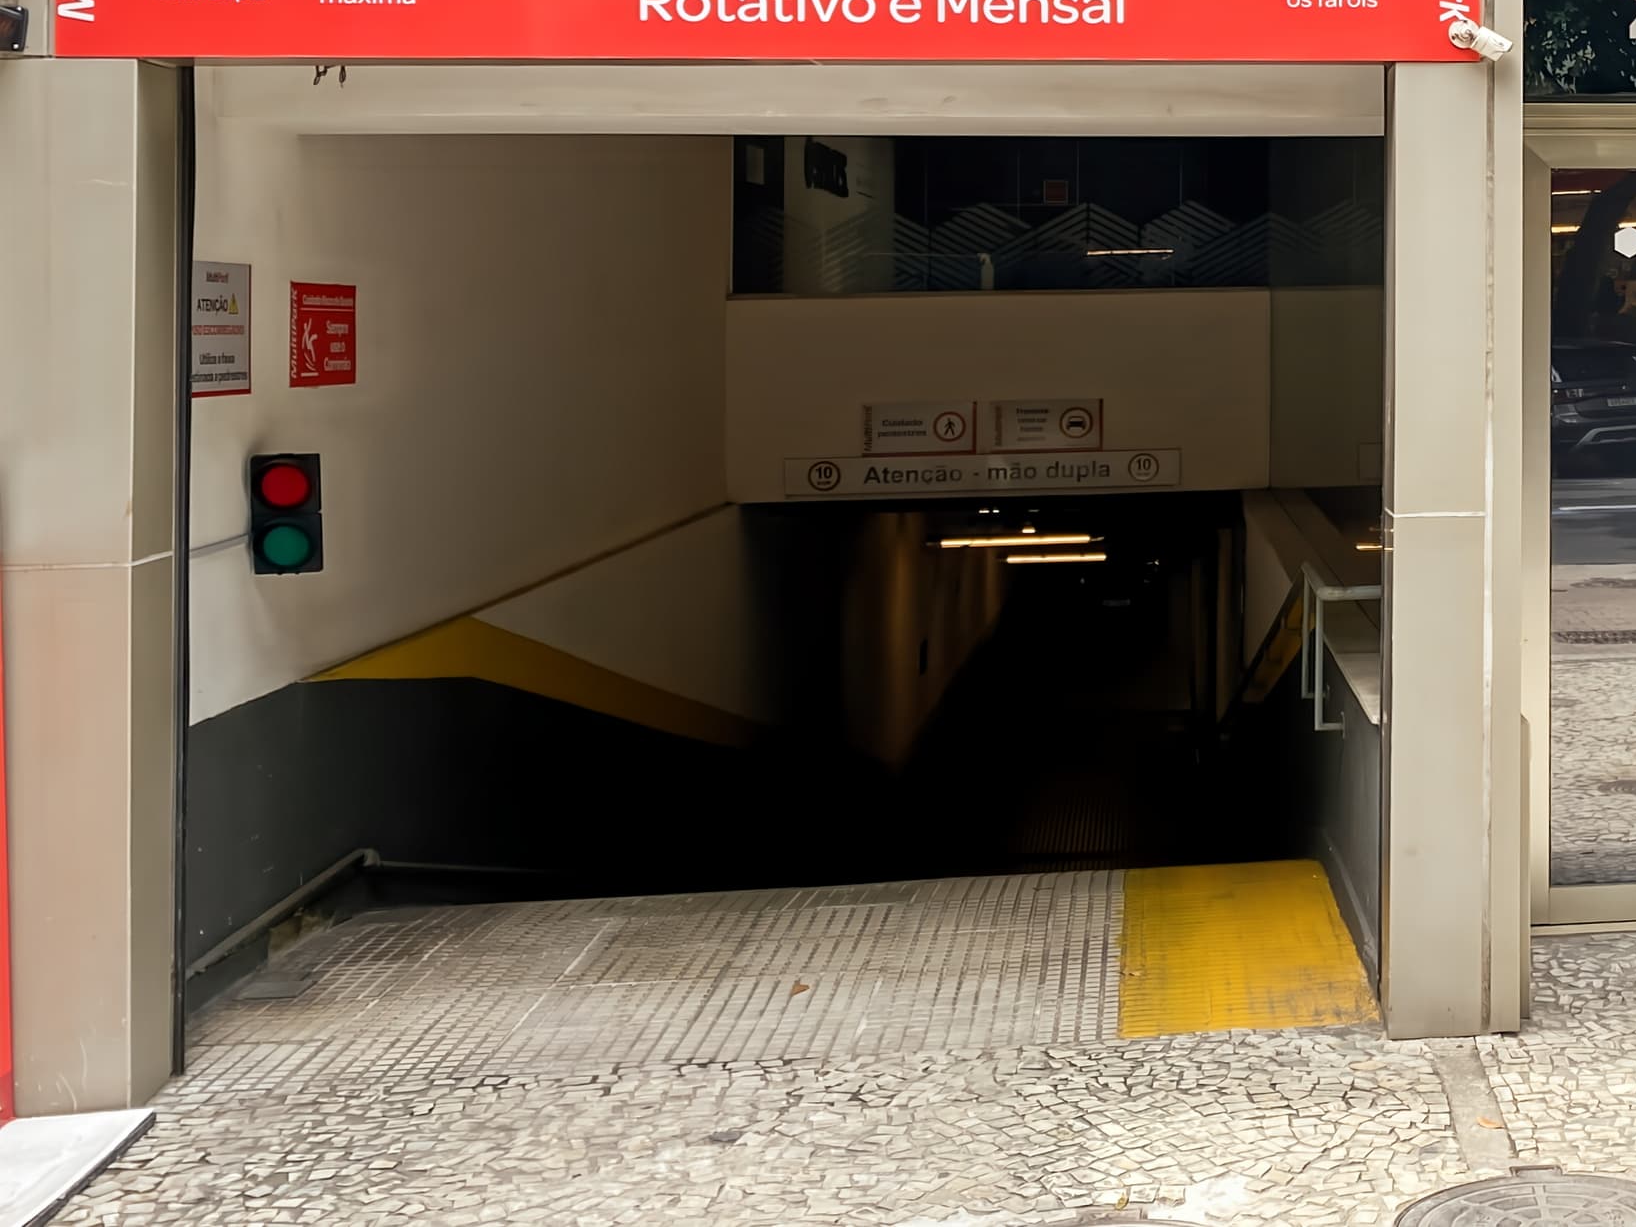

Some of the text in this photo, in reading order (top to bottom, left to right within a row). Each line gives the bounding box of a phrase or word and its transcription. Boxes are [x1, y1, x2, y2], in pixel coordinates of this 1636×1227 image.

[864, 465, 963, 486] Atenção
[987, 463, 1036, 481] mão
[1045, 460, 1111, 483] dupla
